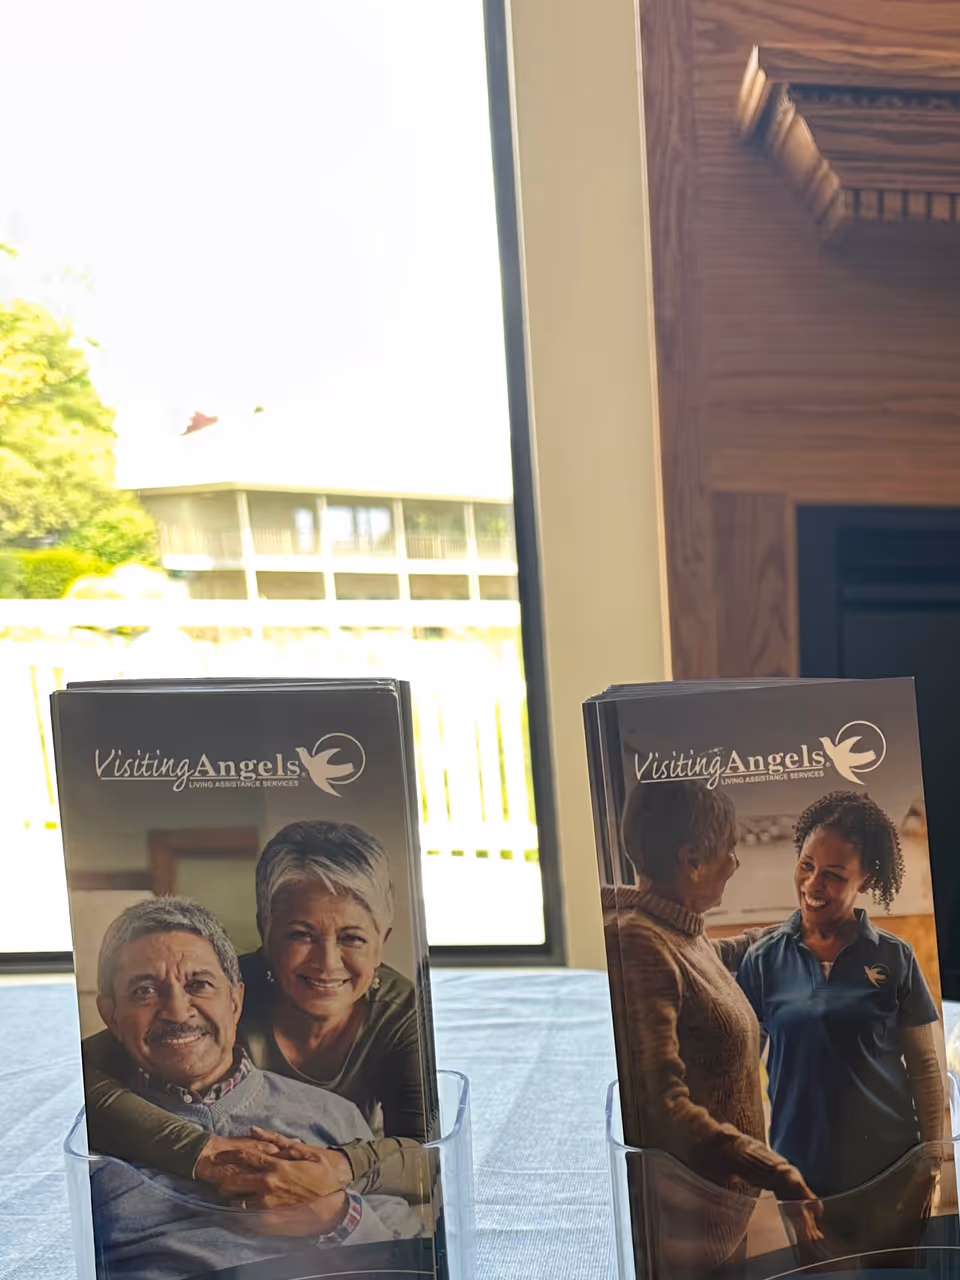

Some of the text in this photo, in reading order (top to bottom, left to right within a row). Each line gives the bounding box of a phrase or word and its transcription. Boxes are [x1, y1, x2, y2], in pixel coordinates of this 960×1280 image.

[95, 749, 300, 791] Visiting Angels
[634, 745, 825, 790] Visiting Angels
[721, 770, 824, 785] LIVING ASSISTANCE SERVICES
[188, 780, 299, 788] LIVING ASSISTANCE SERVICES
